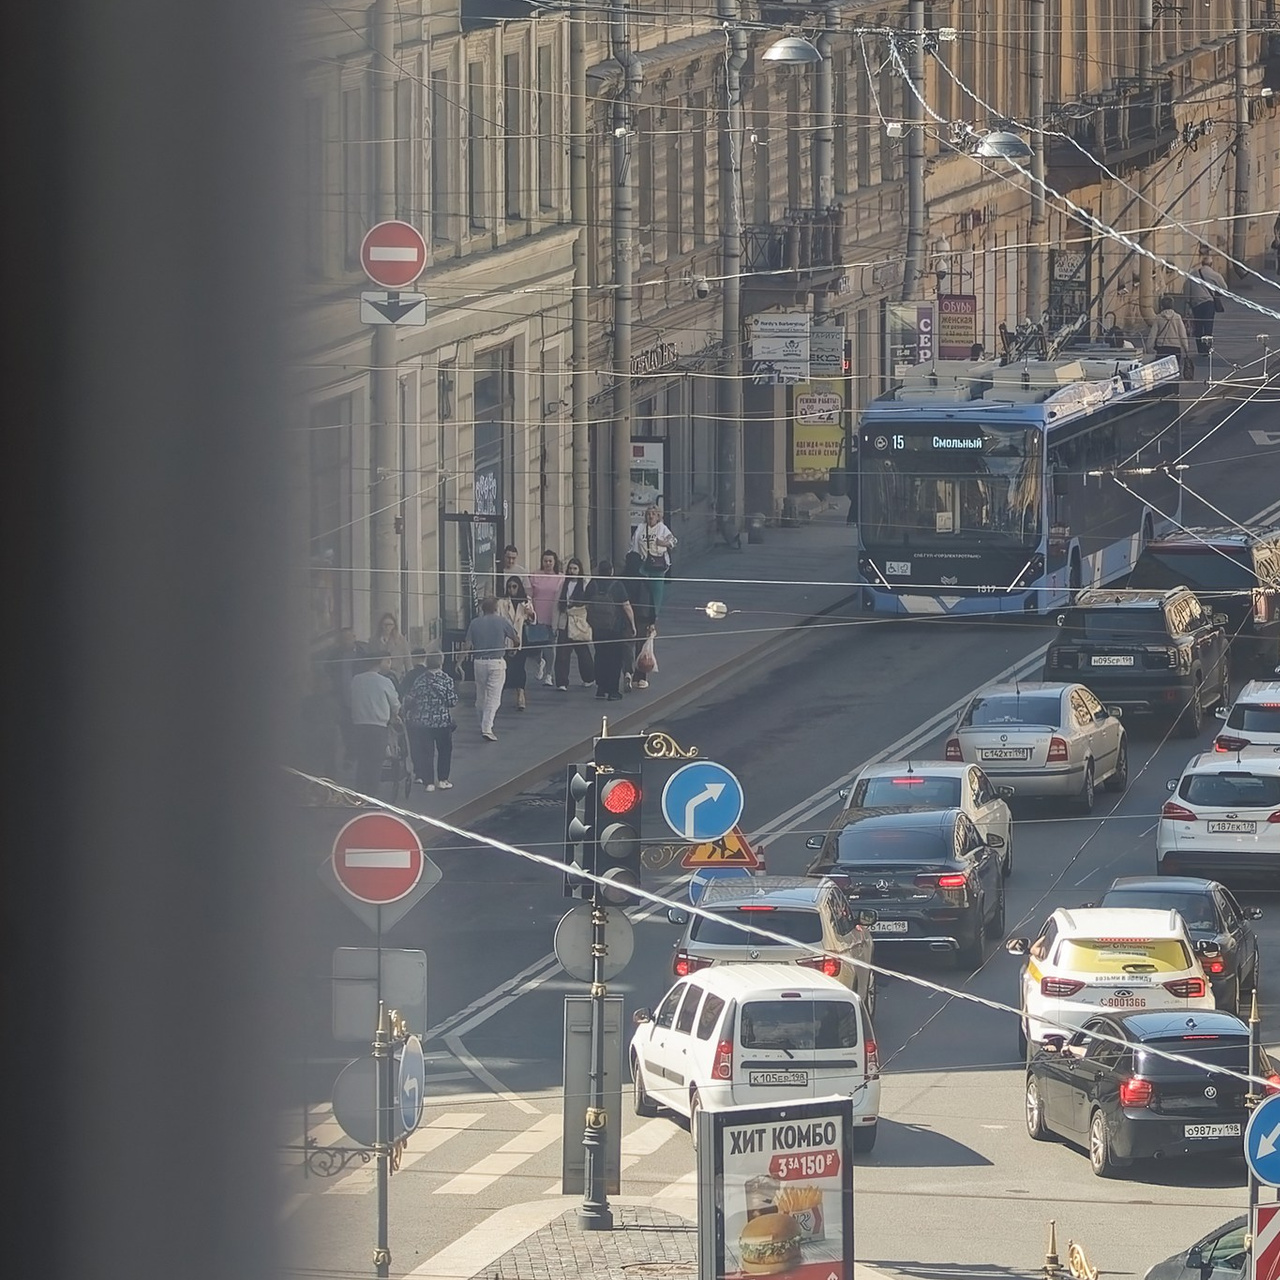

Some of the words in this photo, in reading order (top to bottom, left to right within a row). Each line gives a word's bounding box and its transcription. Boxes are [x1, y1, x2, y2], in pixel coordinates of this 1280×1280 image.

[942, 301, 972, 313] ОБУВЬ
[892, 435, 905, 449] 15
[932, 436, 983, 449] Смольный
[1108, 998, 1146, 1007] 9001366
[1186, 1125, 1223, 1136] О987РУ
[729, 1127, 767, 1156] ХИТ
[771, 1121, 837, 1151] КОМБО
